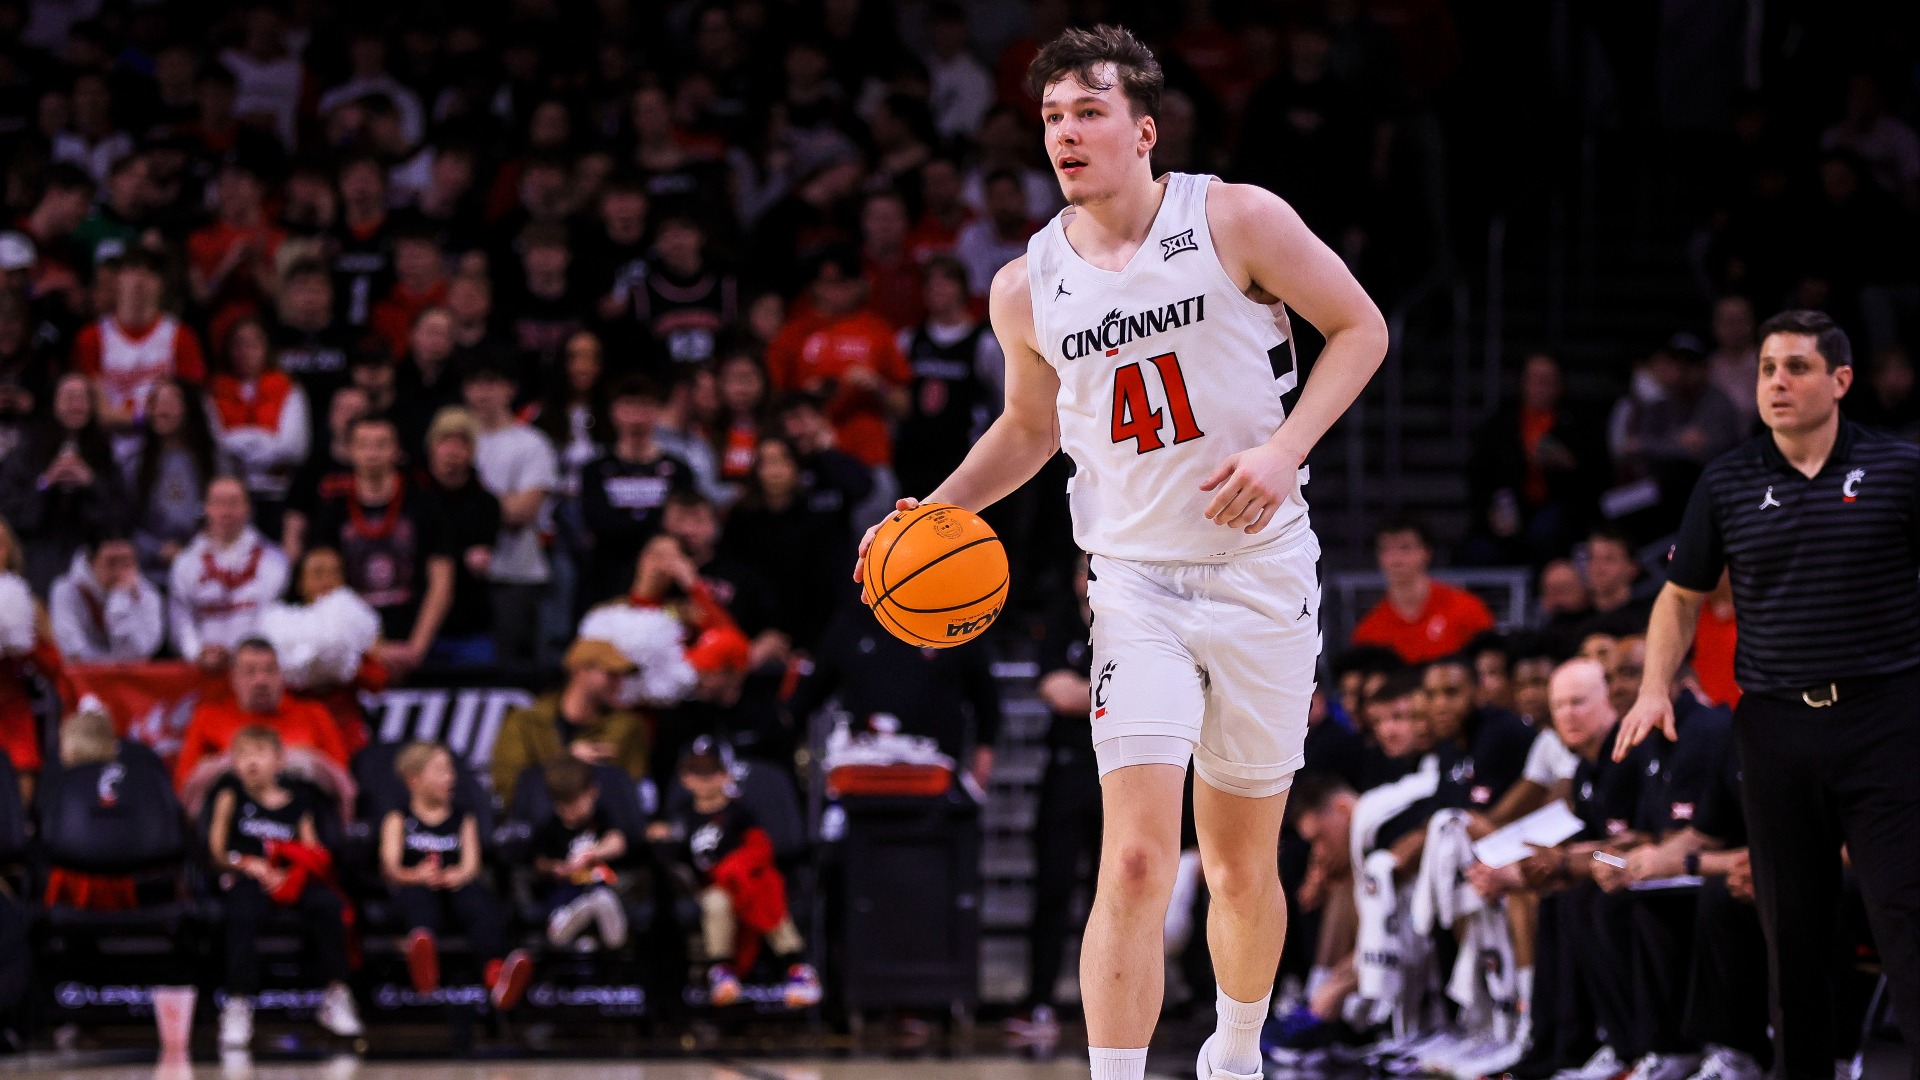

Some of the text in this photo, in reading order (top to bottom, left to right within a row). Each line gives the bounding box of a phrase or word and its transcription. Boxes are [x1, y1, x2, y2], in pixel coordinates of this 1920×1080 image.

[1062, 294, 1206, 360] CINCINNATI
[1111, 351, 1205, 455] 41
[946, 603, 1003, 637] NCAA
